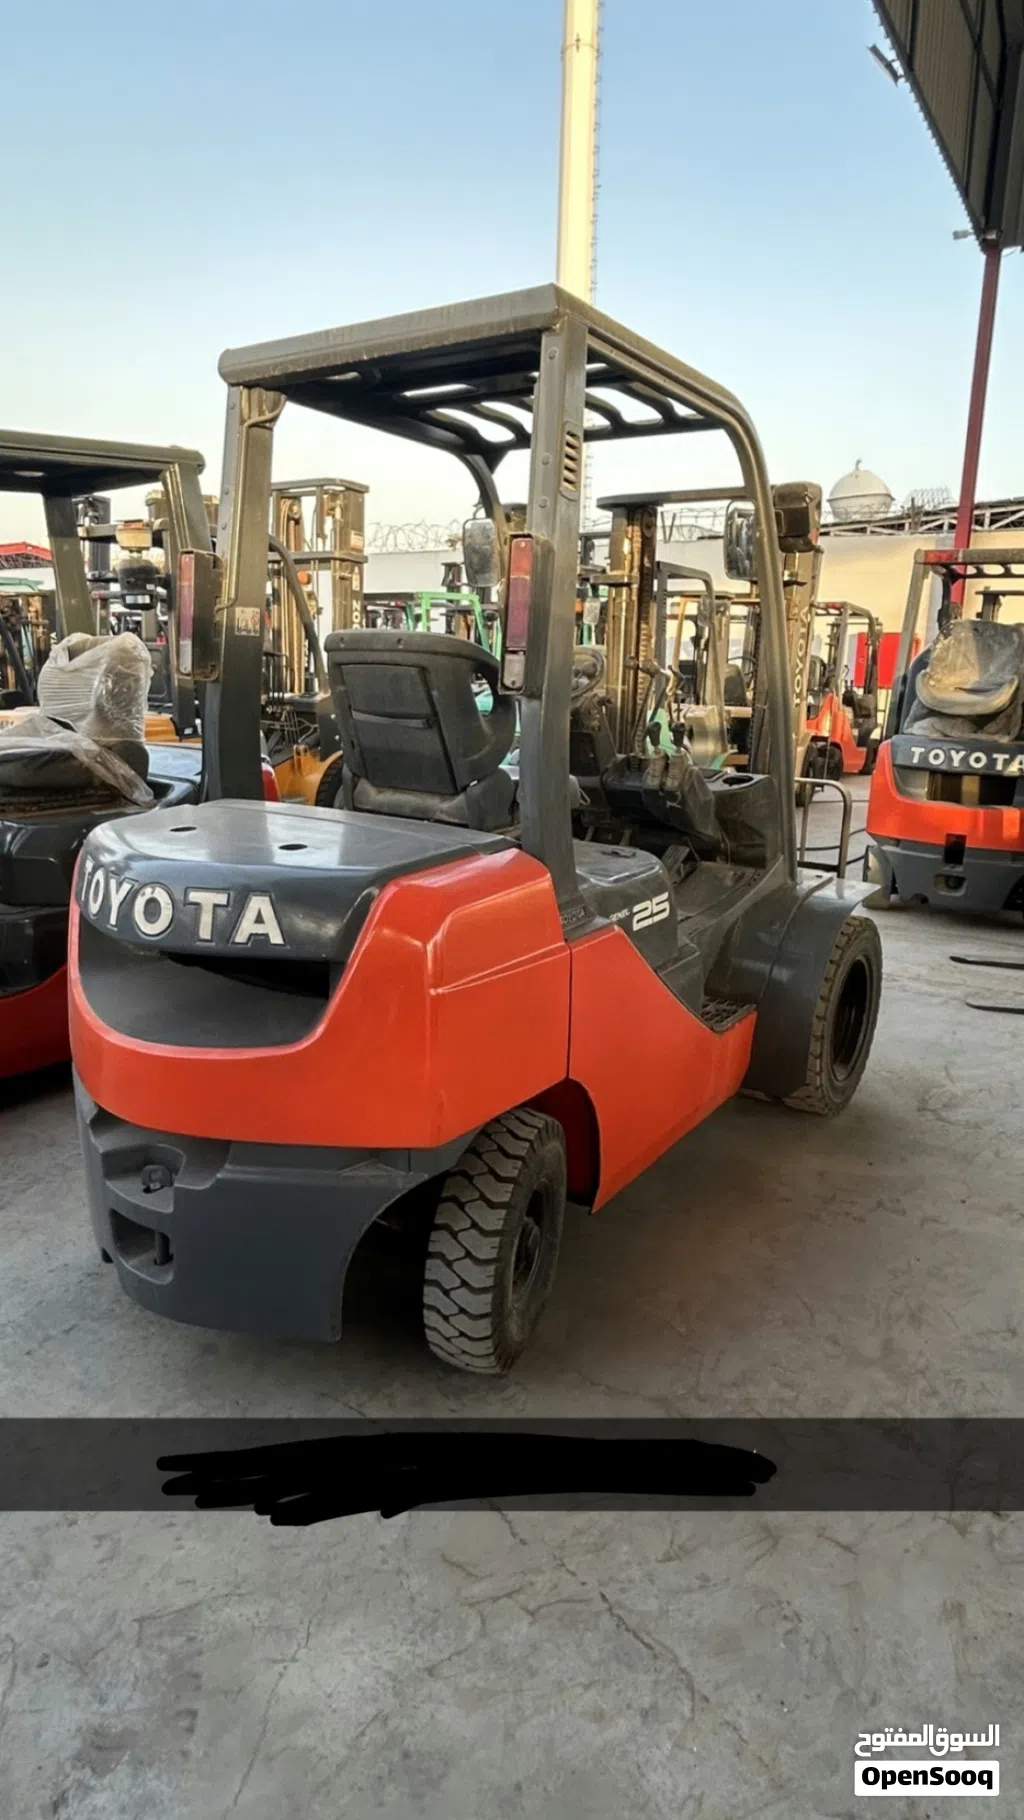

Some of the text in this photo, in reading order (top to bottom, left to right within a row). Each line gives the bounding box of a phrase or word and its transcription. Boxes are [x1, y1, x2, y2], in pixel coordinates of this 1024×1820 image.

[793, 606, 810, 708] TOYOTA
[81, 855, 285, 946] TOYOTA
[632, 891, 670, 932] 25
